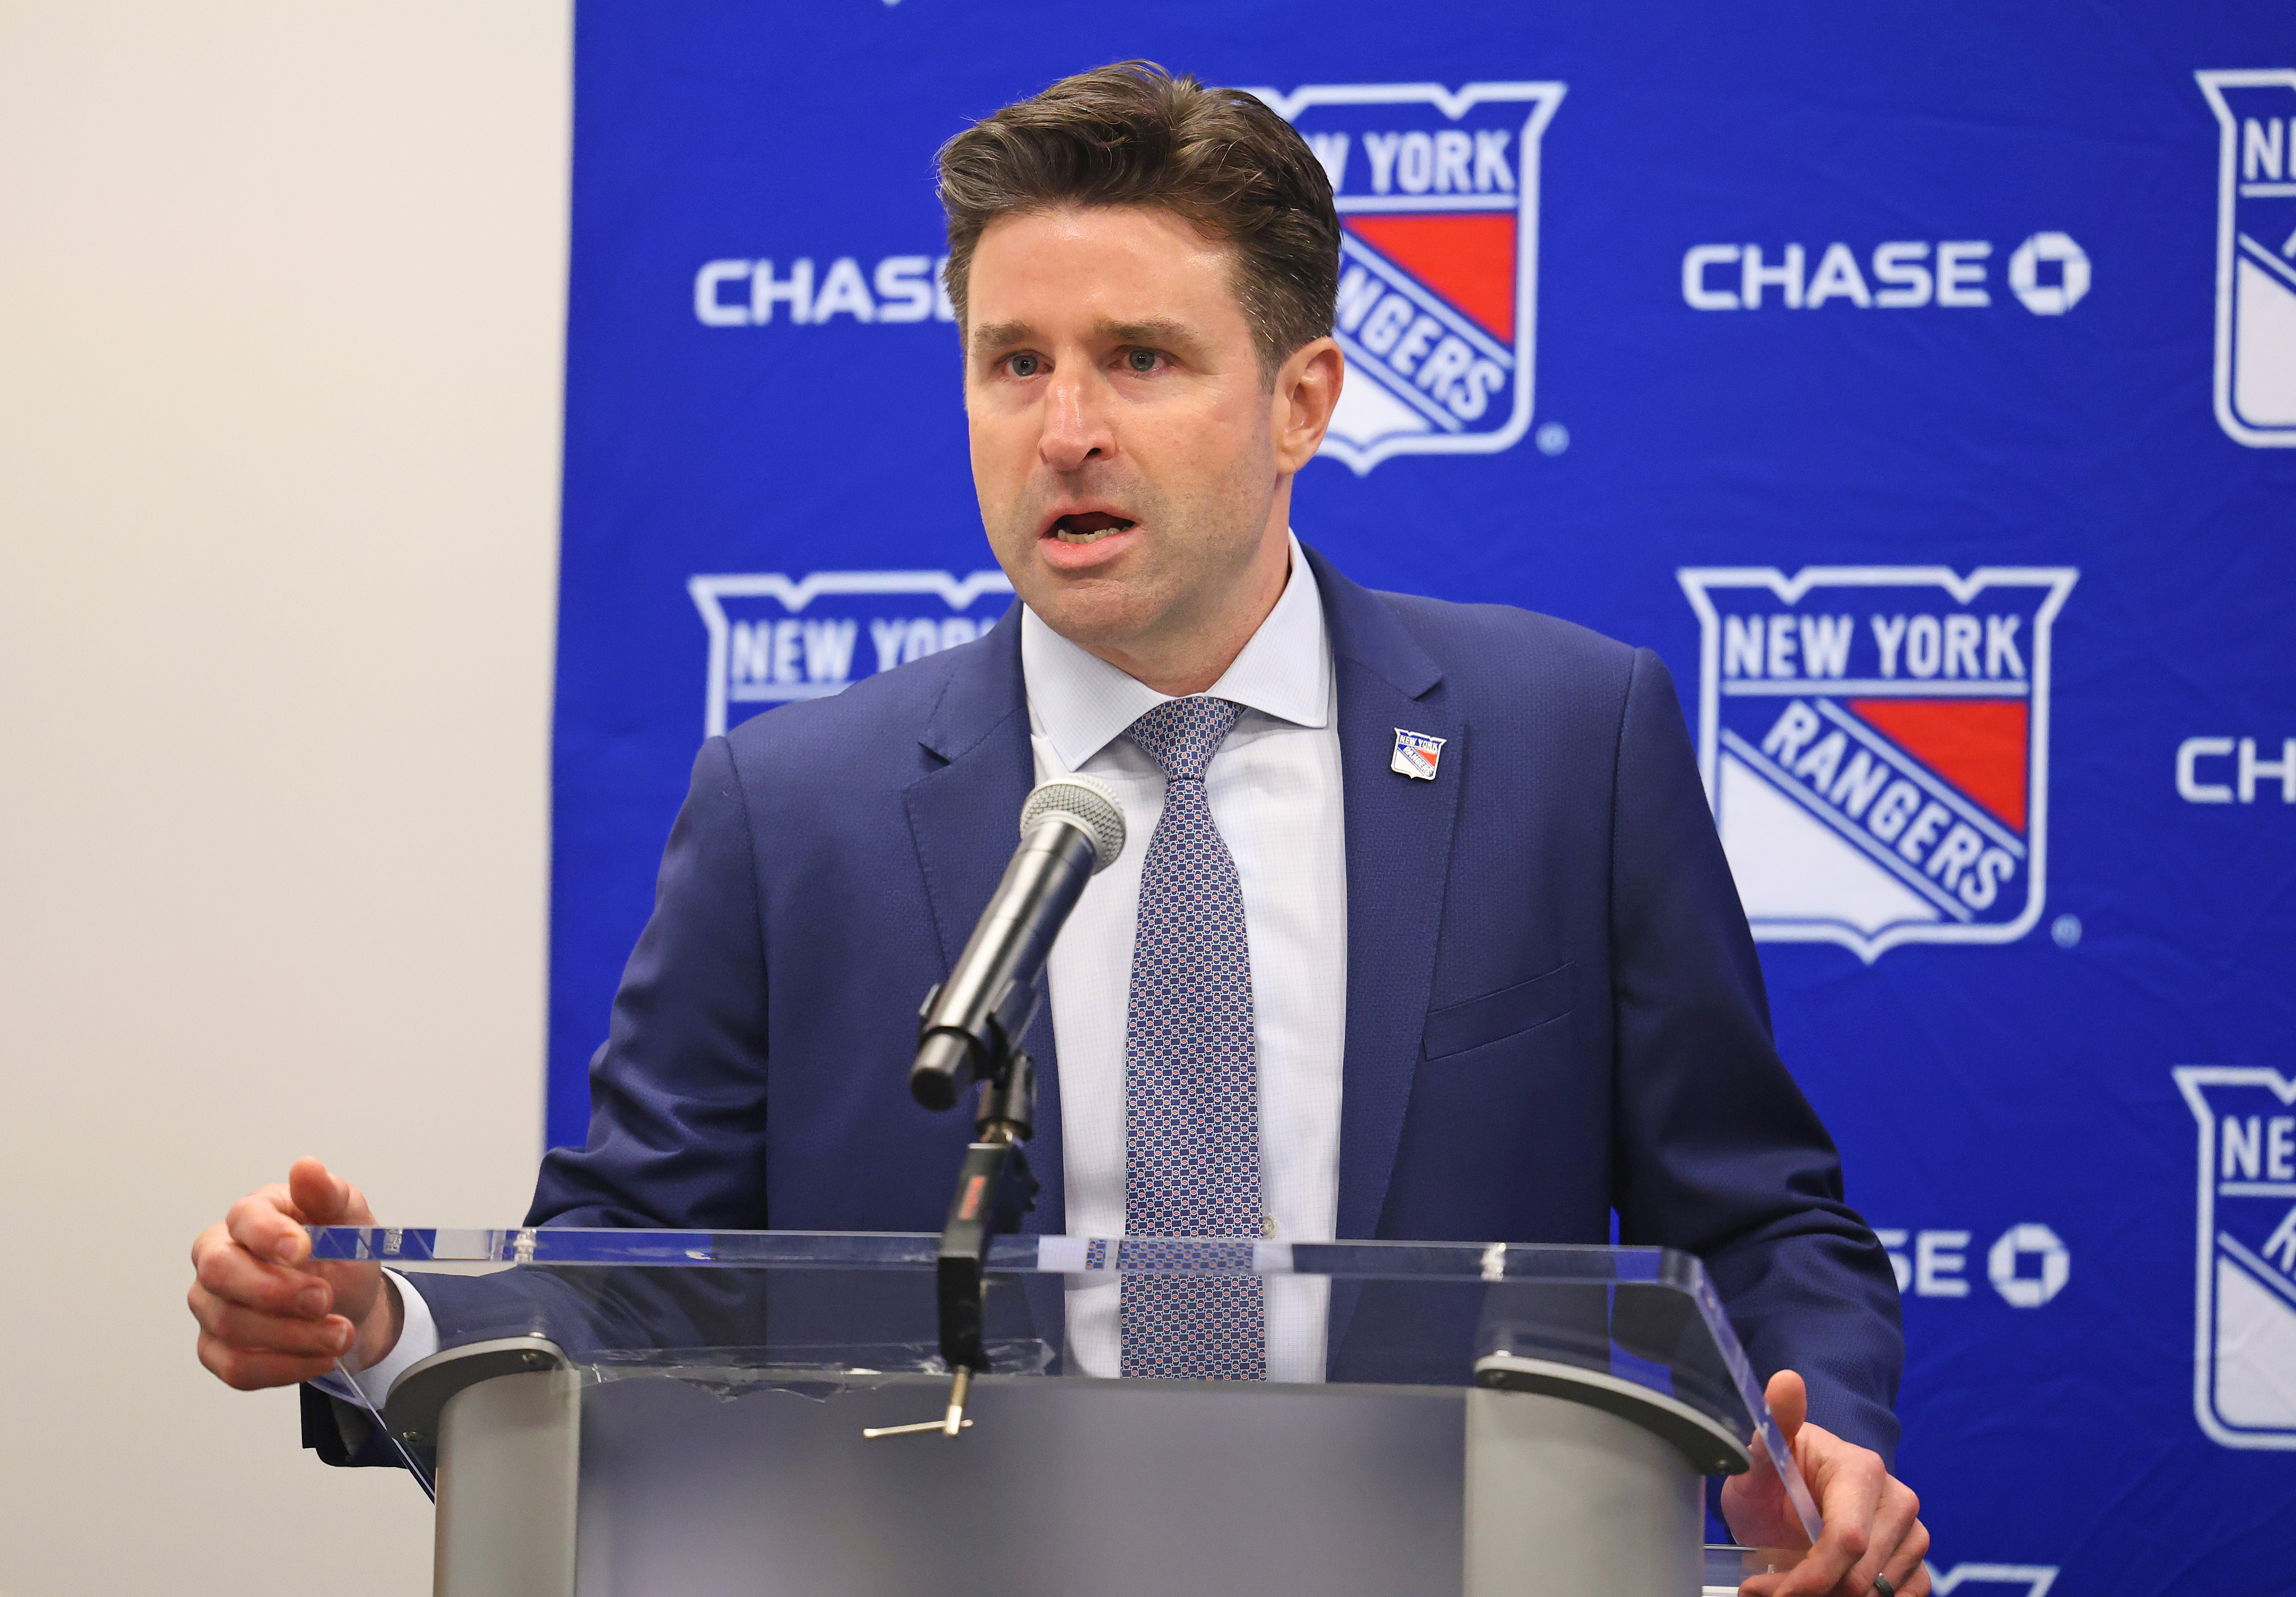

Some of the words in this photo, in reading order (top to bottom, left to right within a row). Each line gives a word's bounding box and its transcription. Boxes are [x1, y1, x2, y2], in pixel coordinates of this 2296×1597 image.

[1363, 130, 1515, 194] YORK
[1682, 241, 1992, 310] CHASE
[1334, 263, 1505, 421] NGERS
[733, 618, 857, 683] NEW
[1723, 614, 1853, 678] NEW
[1870, 614, 2027, 679] YORK
[1400, 735, 1417, 745] NEW
[1418, 739, 1438, 751] YORK
[1403, 746, 1434, 776] RANGERS
[1761, 700, 2015, 911] RANGERS
[2222, 1116, 2296, 1179] NE
